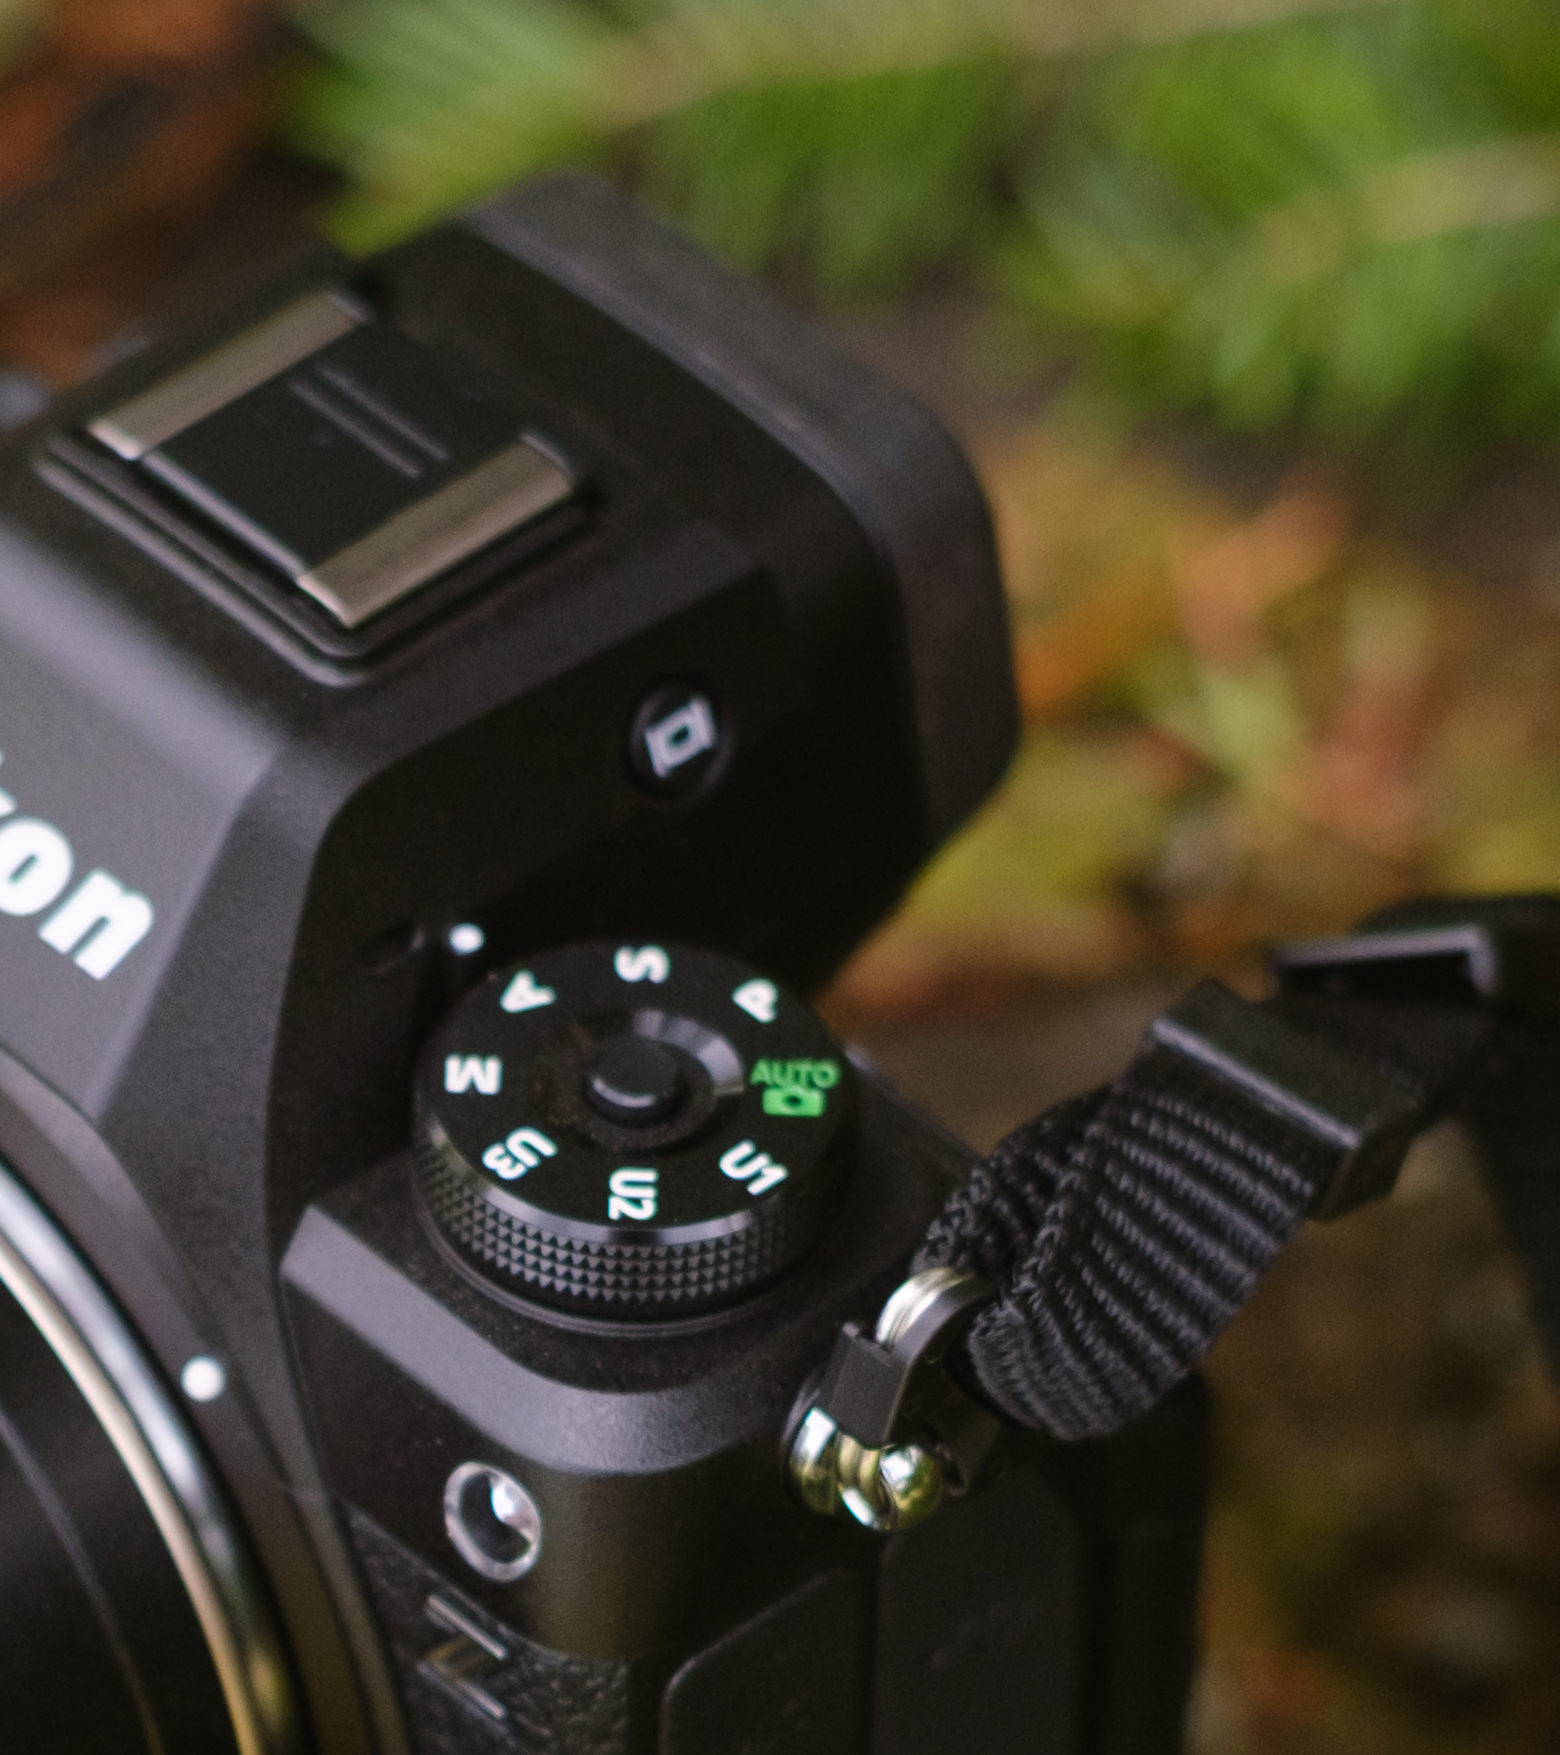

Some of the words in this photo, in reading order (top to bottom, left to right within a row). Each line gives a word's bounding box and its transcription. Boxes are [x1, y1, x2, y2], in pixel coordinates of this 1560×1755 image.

[614, 946, 670, 984] S
[500, 970, 556, 1014] A
[732, 978, 779, 1023] P
[443, 1054, 503, 1096] M
[750, 1058, 841, 1088] AUTO
[482, 1127, 557, 1181] U3
[719, 1140, 788, 1196] U1
[607, 1166, 659, 1222] U2
